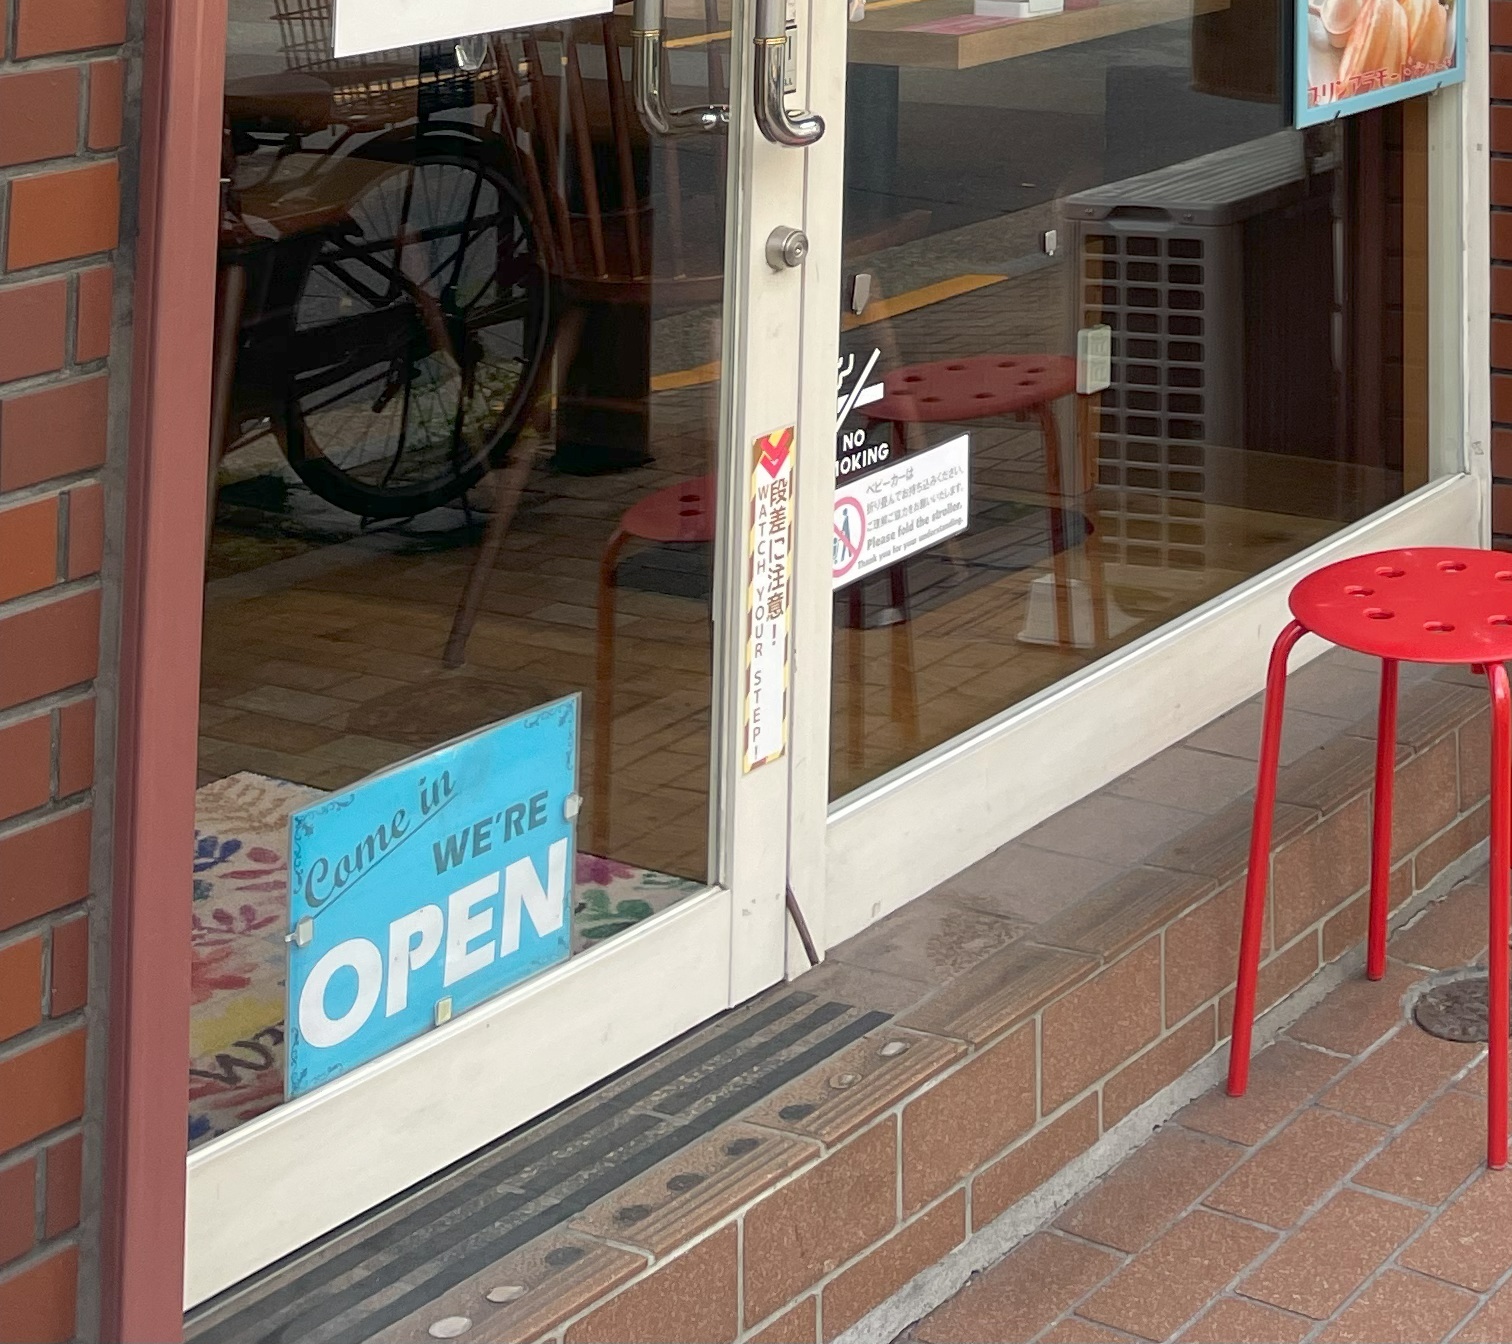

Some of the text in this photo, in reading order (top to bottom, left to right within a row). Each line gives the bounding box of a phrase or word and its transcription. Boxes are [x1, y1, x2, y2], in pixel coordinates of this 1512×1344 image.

[835, 442, 890, 477] OKING
[842, 428, 866, 453] NO
[866, 466, 914, 494] ベビーカーは
[866, 530, 896, 552] Please
[897, 519, 914, 538] fold
[916, 514, 930, 529] the
[751, 484, 770, 761] WATCH YOUR STEP!
[304, 768, 458, 908] Come in
[432, 790, 549, 877] WE'RE
[298, 837, 568, 1049] OPEN
